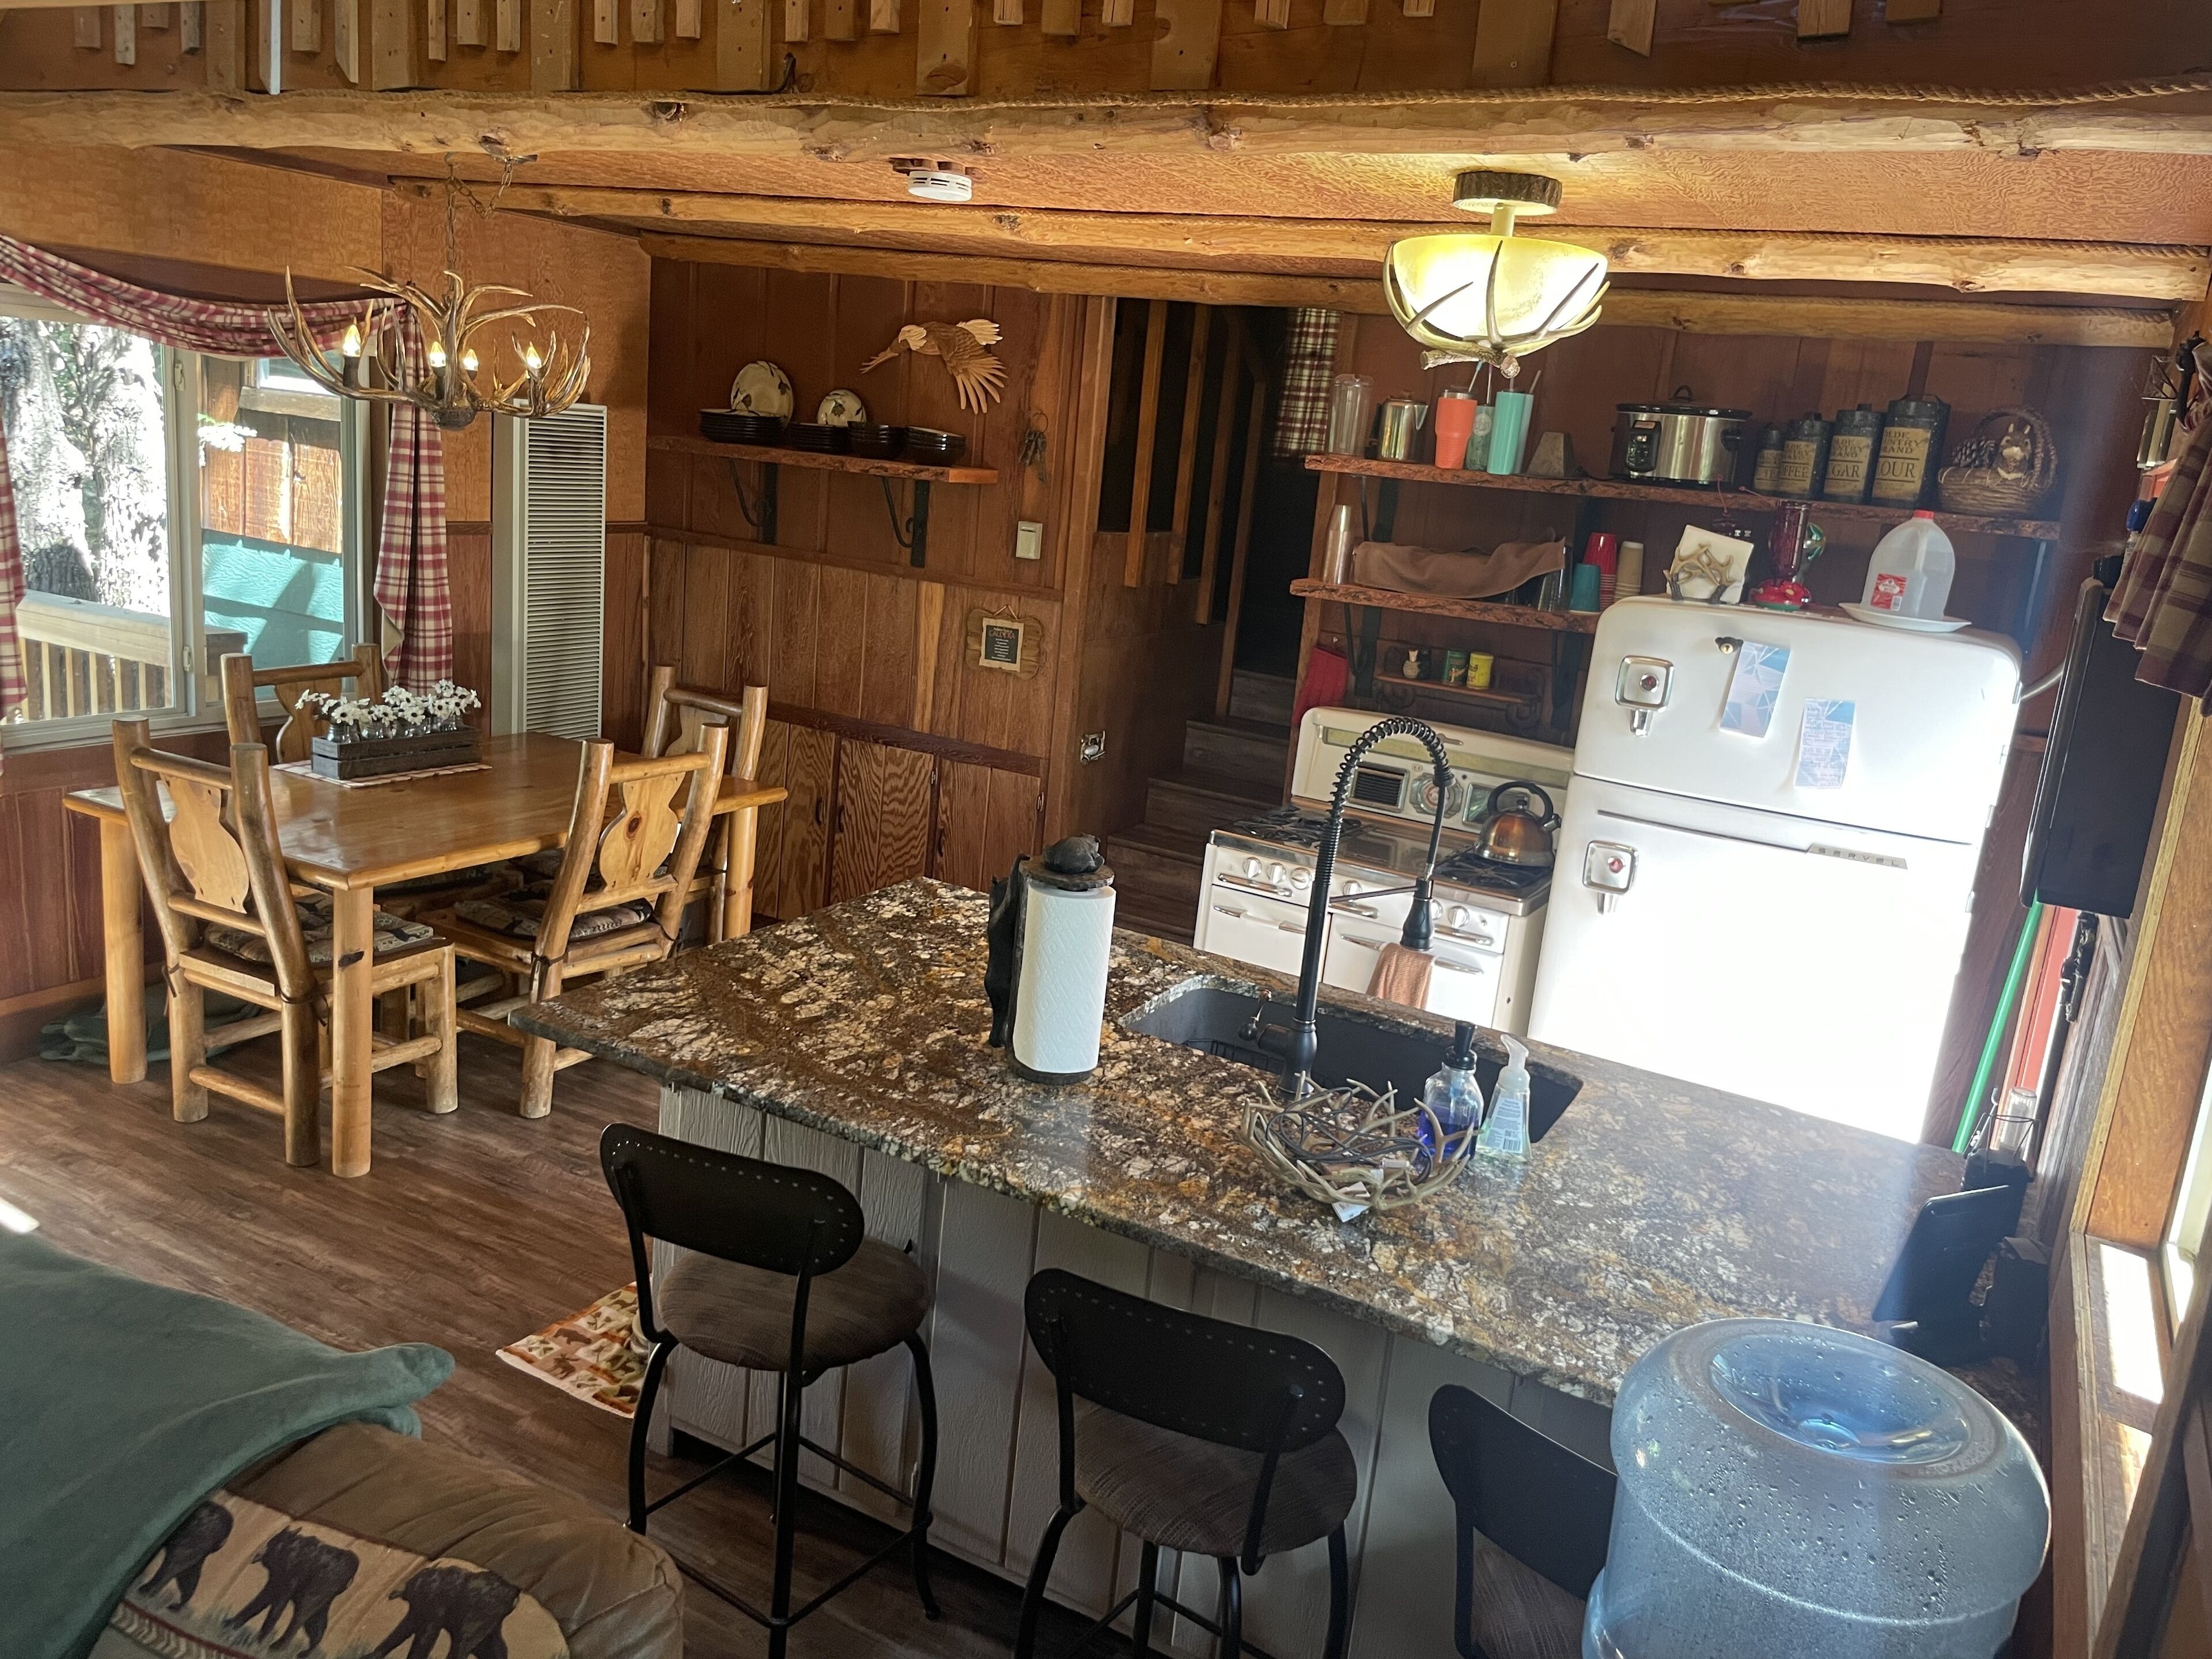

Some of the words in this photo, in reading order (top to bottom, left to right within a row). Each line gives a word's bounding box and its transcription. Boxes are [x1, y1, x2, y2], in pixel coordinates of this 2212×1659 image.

[1831, 463, 1860, 478] GAR
[1880, 460, 1915, 478] OUR
[1819, 847, 1899, 866] SERVEL
